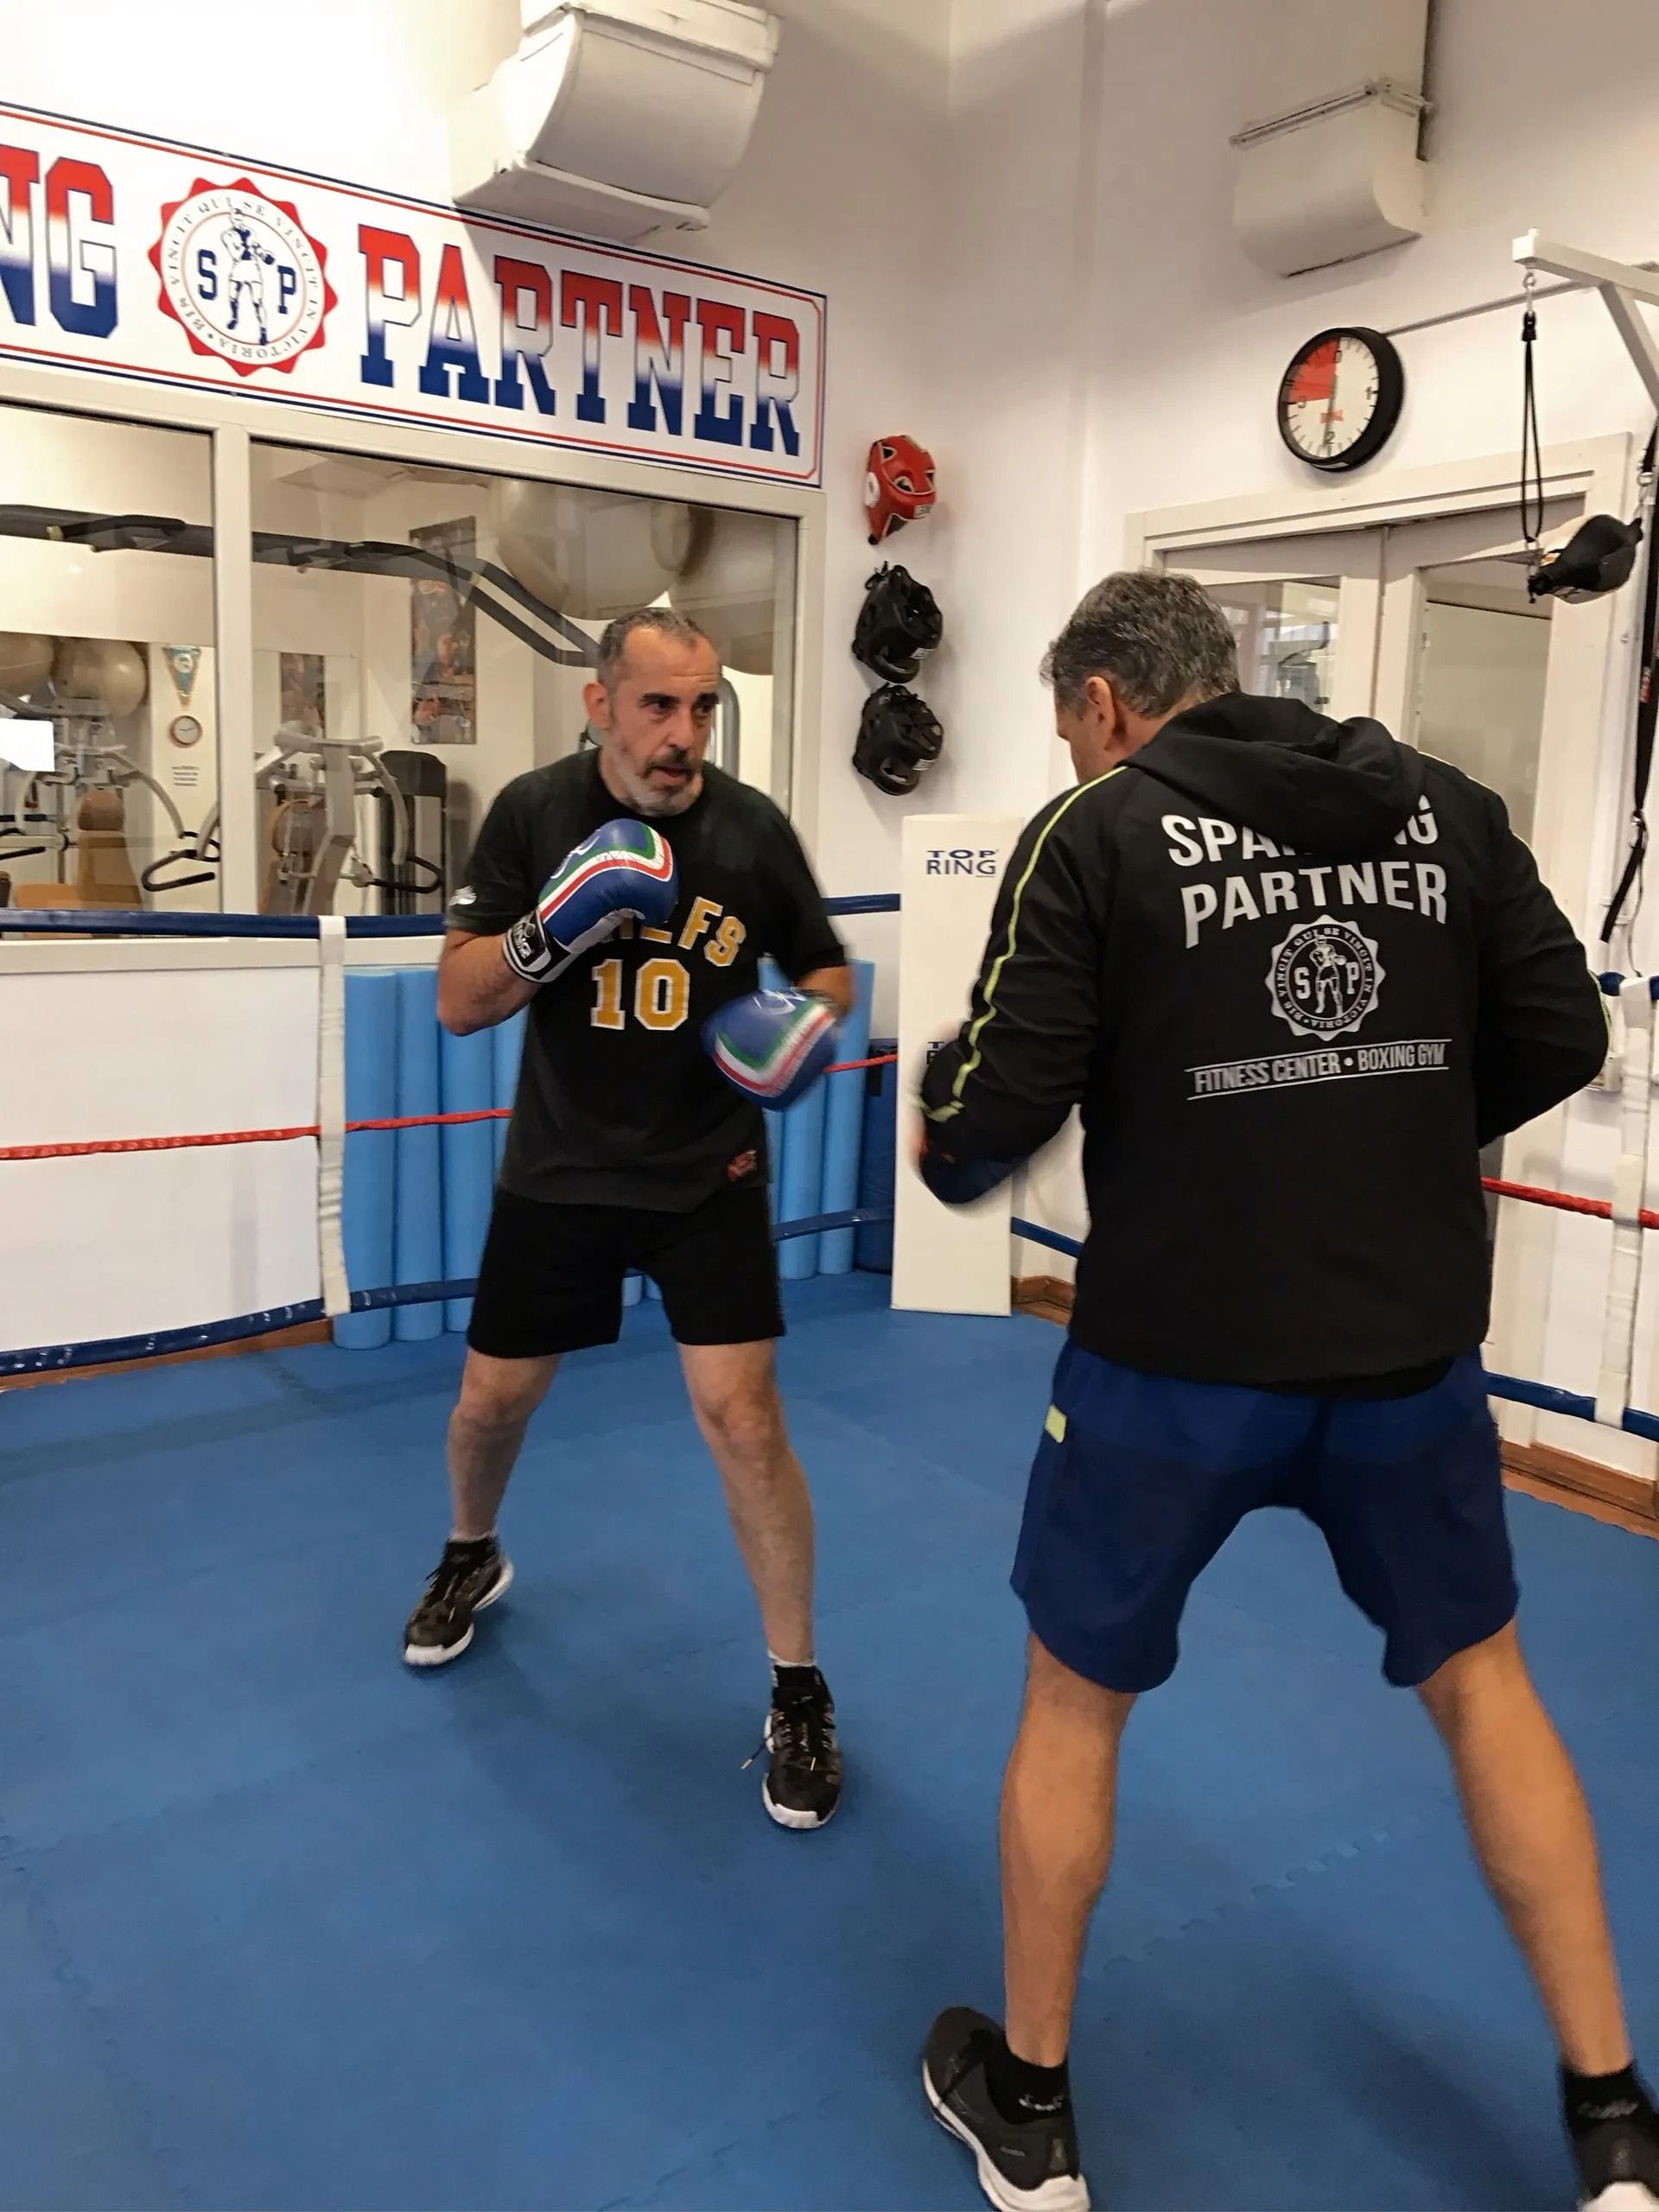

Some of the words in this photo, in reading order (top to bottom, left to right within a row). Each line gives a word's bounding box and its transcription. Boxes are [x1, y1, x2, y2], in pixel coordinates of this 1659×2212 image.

[197, 248, 217, 301] S
[277, 264, 297, 315] P
[359, 224, 802, 457] PARTNER
[926, 849, 996, 860] TOP
[1161, 794, 1439, 867] SPAG
[926, 860, 996, 876] RING
[1180, 861, 1447, 950] PARTNER
[590, 958, 690, 1031] 10
[1294, 966, 1312, 1000] S
[1345, 961, 1361, 995] P
[1194, 1061, 1270, 1093] FITNESS
[1271, 1052, 1342, 1082] CENTER
[1357, 1044, 1416, 1071] BOXING
[1417, 1043, 1446, 1066] GYM
